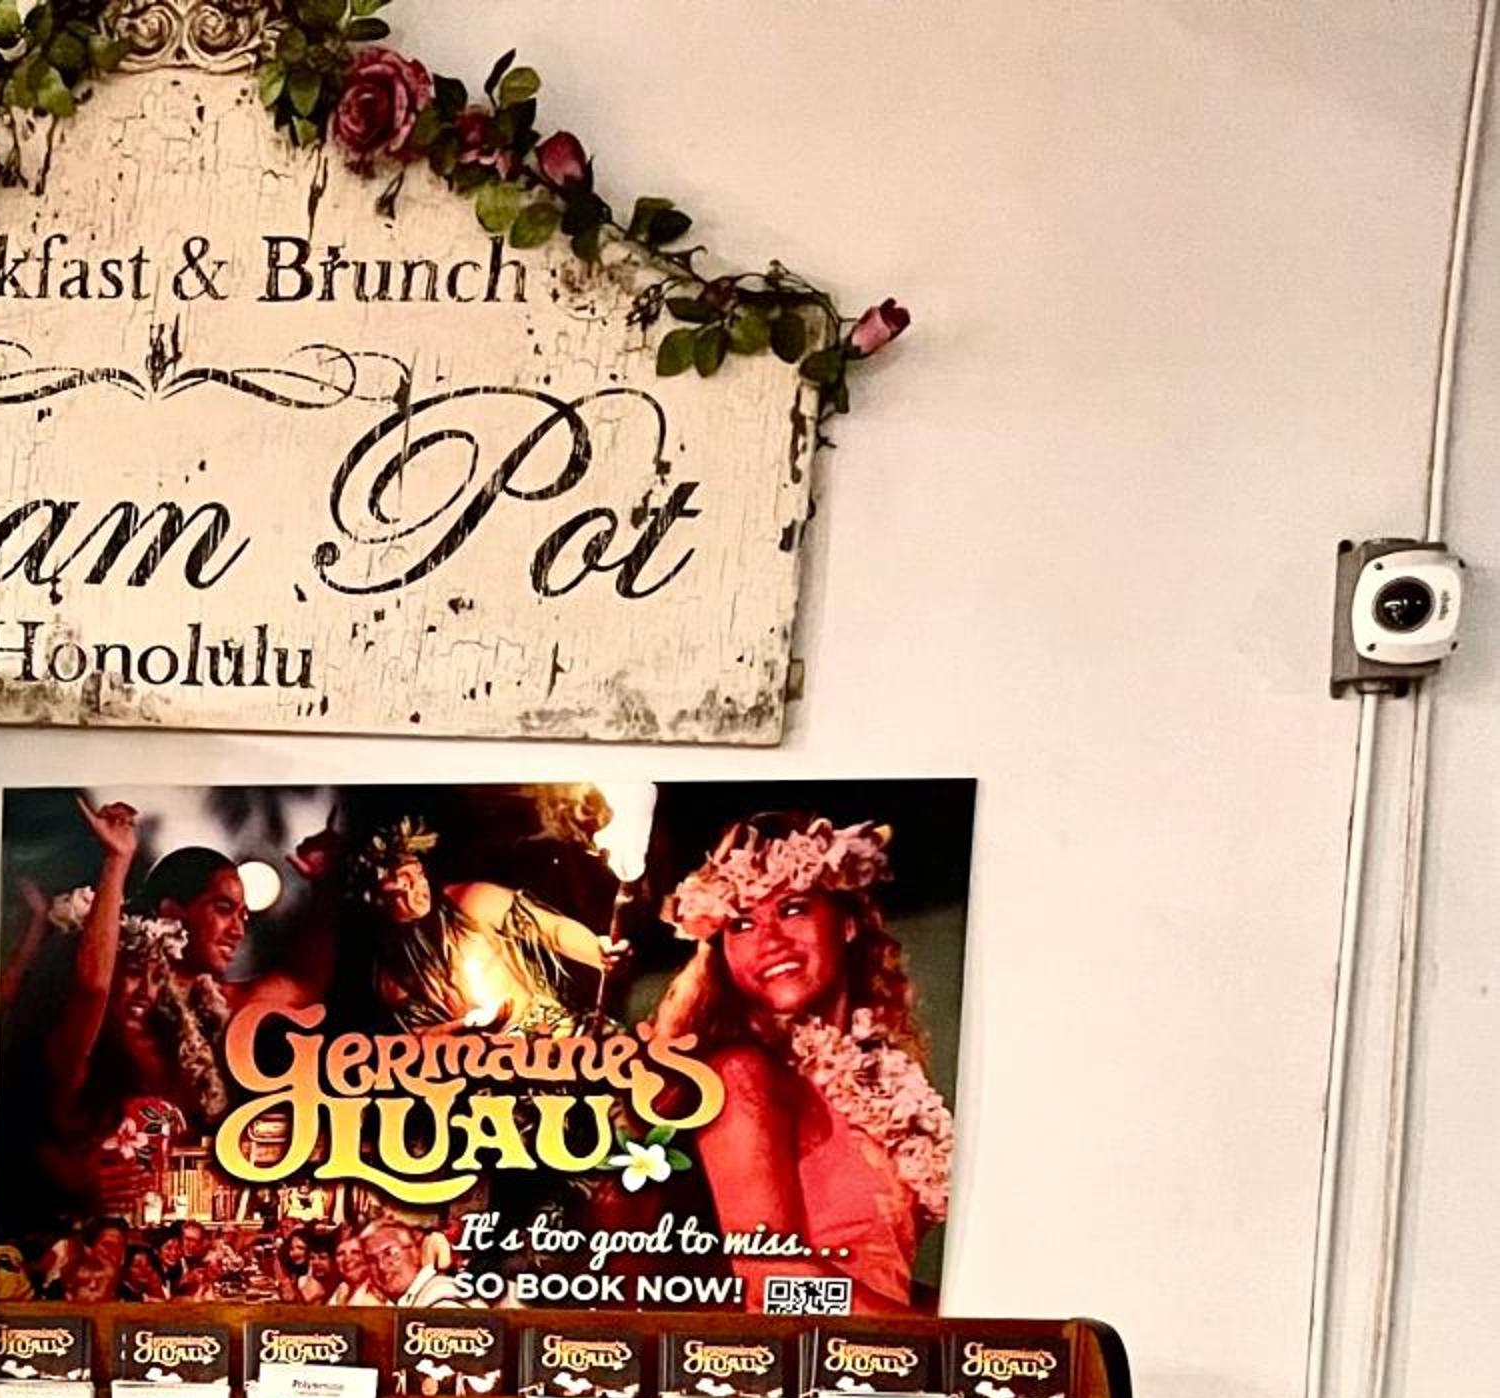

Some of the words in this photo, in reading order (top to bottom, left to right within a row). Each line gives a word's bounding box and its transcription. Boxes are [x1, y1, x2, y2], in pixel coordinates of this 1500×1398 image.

[173, 235, 228, 301] &
[257, 235, 528, 303] Brunch
[313, 387, 700, 598] Pot
[225, 1001, 724, 1130] Germaine's
[214, 1093, 614, 1204] LUAU
[453, 1214, 517, 1251] It's
[527, 1215, 586, 1251] too
[590, 1214, 672, 1270] good
[679, 1217, 717, 1253] to
[455, 1273, 503, 1299] SO
[517, 1275, 624, 1302] BOOK
[637, 1278, 742, 1303] NOW!
